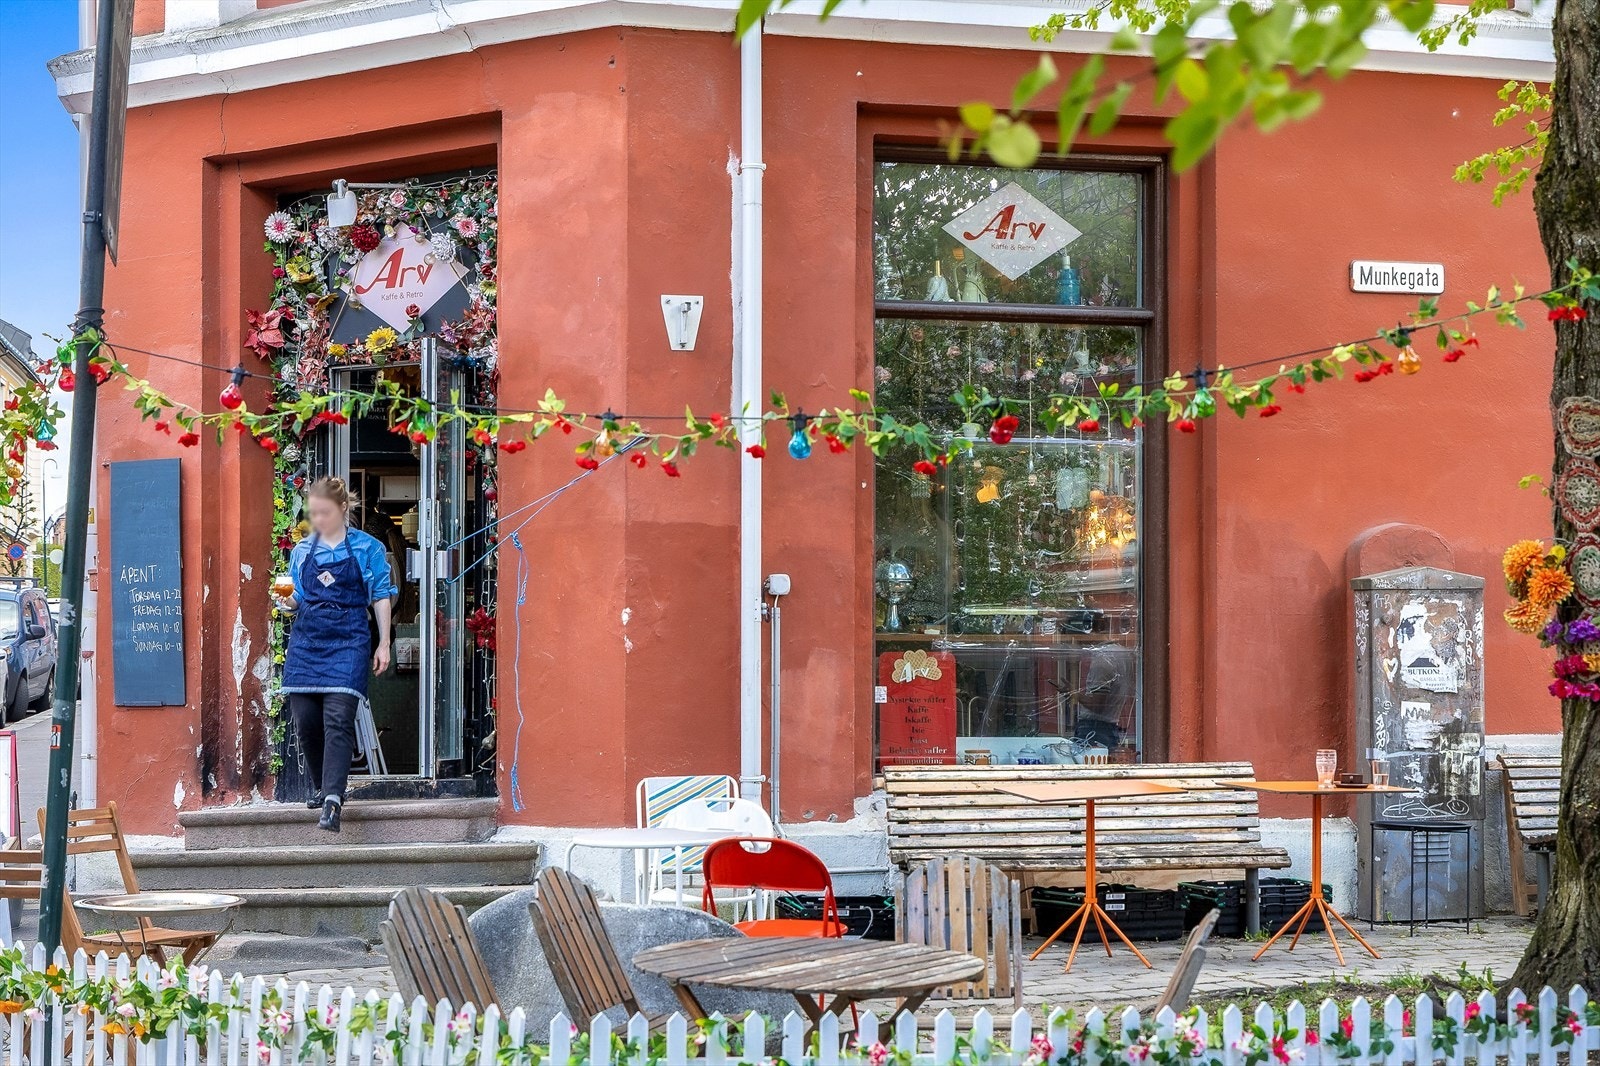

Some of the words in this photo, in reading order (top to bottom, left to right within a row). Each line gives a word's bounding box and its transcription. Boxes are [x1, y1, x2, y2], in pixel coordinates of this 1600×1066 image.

[963, 204, 1046, 241] Arv
[991, 243, 1008, 251] Kaffe
[355, 247, 433, 294] Arv
[1359, 265, 1439, 290] Munkegata
[381, 292, 398, 301] Kaffe
[406, 290, 424, 299] Retro
[132, 604, 161, 616] FREDAG
[900, 662, 930, 682] Arv
[907, 706, 928, 714] Kaffe
[905, 716, 931, 724] Iskaffe
[924, 746, 947, 754] vafler
